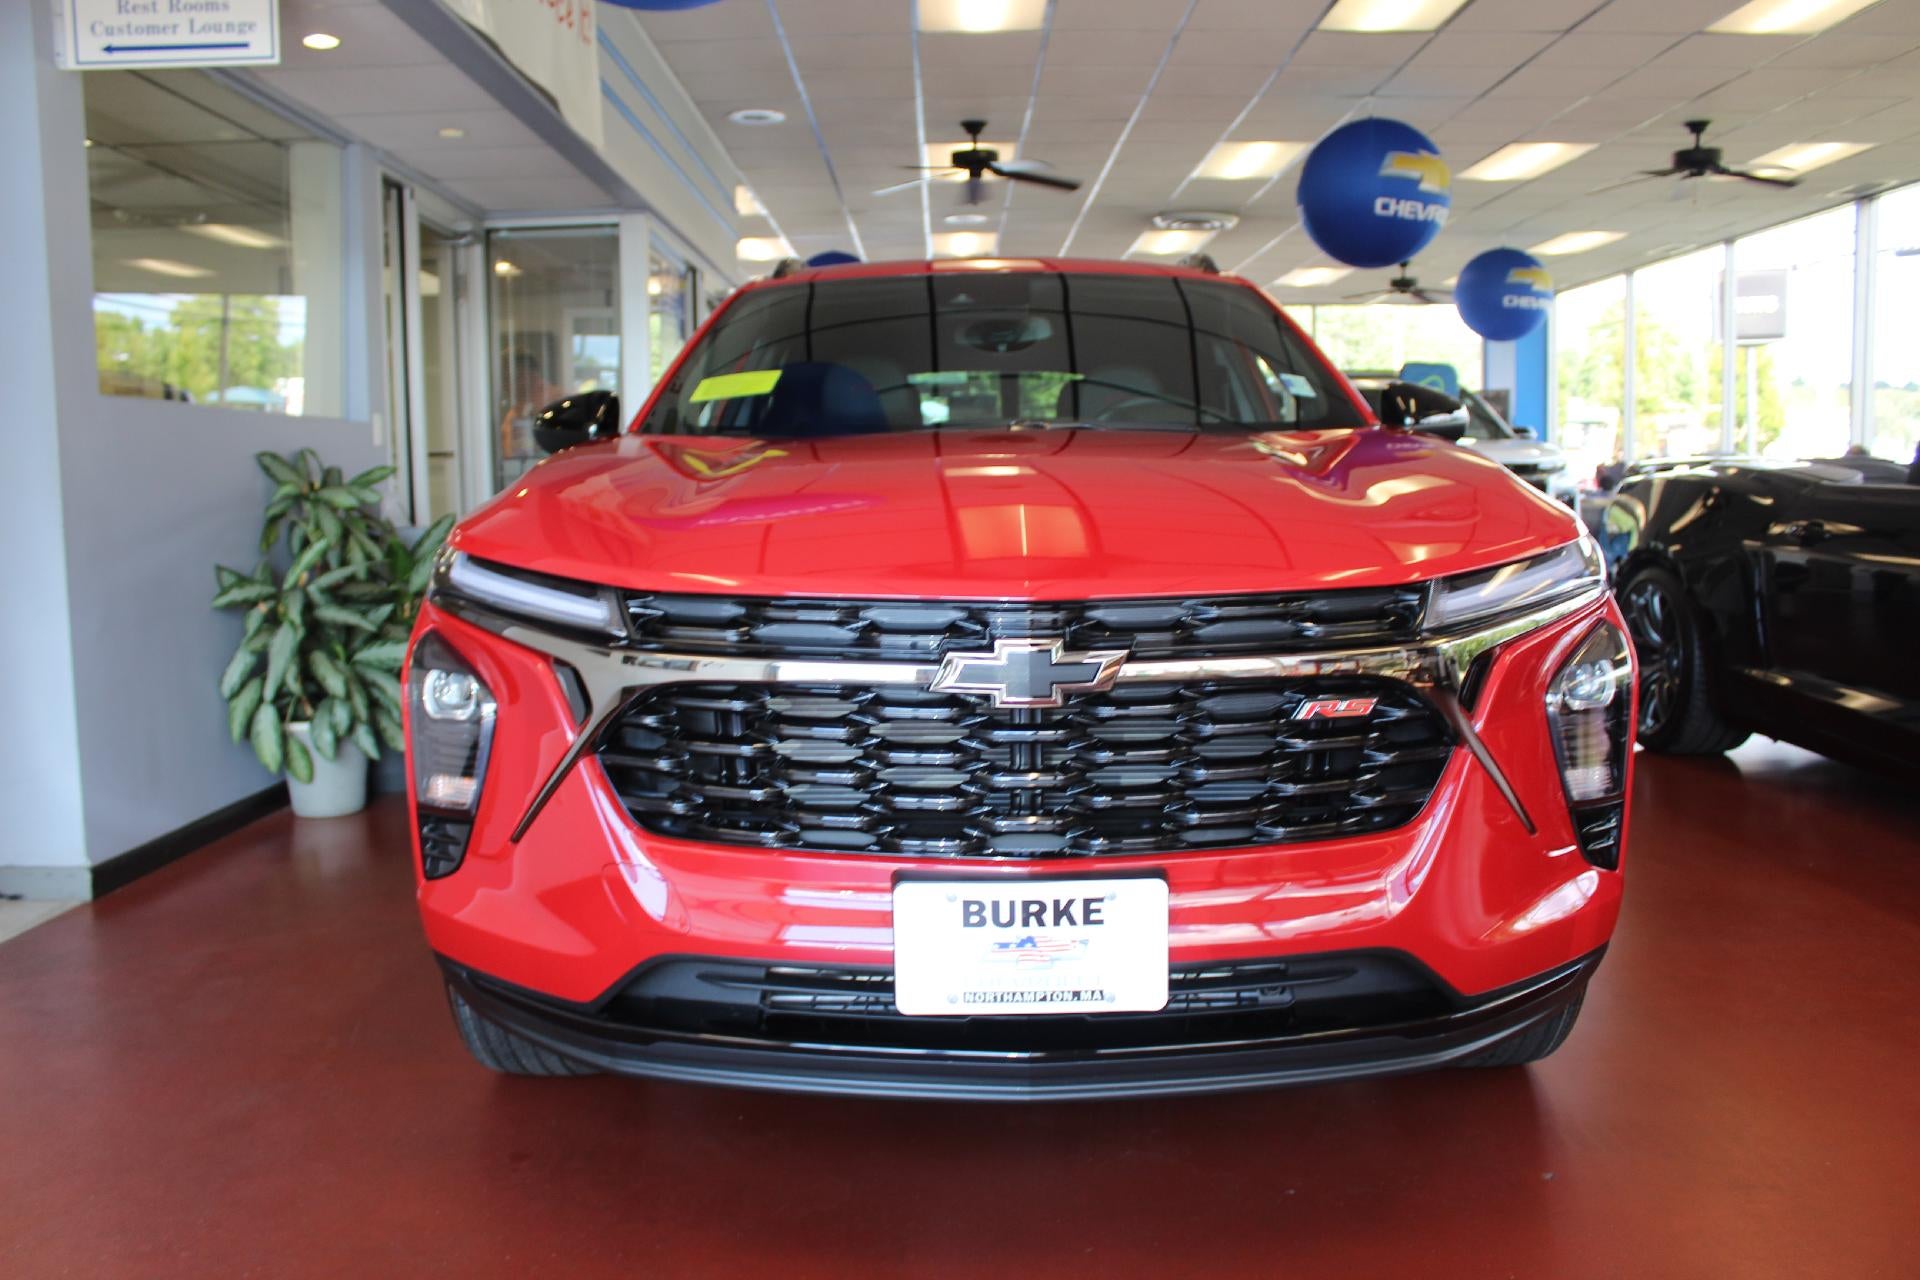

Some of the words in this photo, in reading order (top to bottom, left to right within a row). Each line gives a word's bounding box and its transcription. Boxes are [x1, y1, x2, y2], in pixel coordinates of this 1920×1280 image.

[117, 0, 158, 14] Rest
[168, 0, 231, 13] Rooms
[90, 20, 180, 37] Customer
[189, 17, 257, 35] Lounge
[1294, 698, 1378, 720] RS
[961, 897, 1106, 929] BURKE
[1080, 989, 1103, 1002] MA
